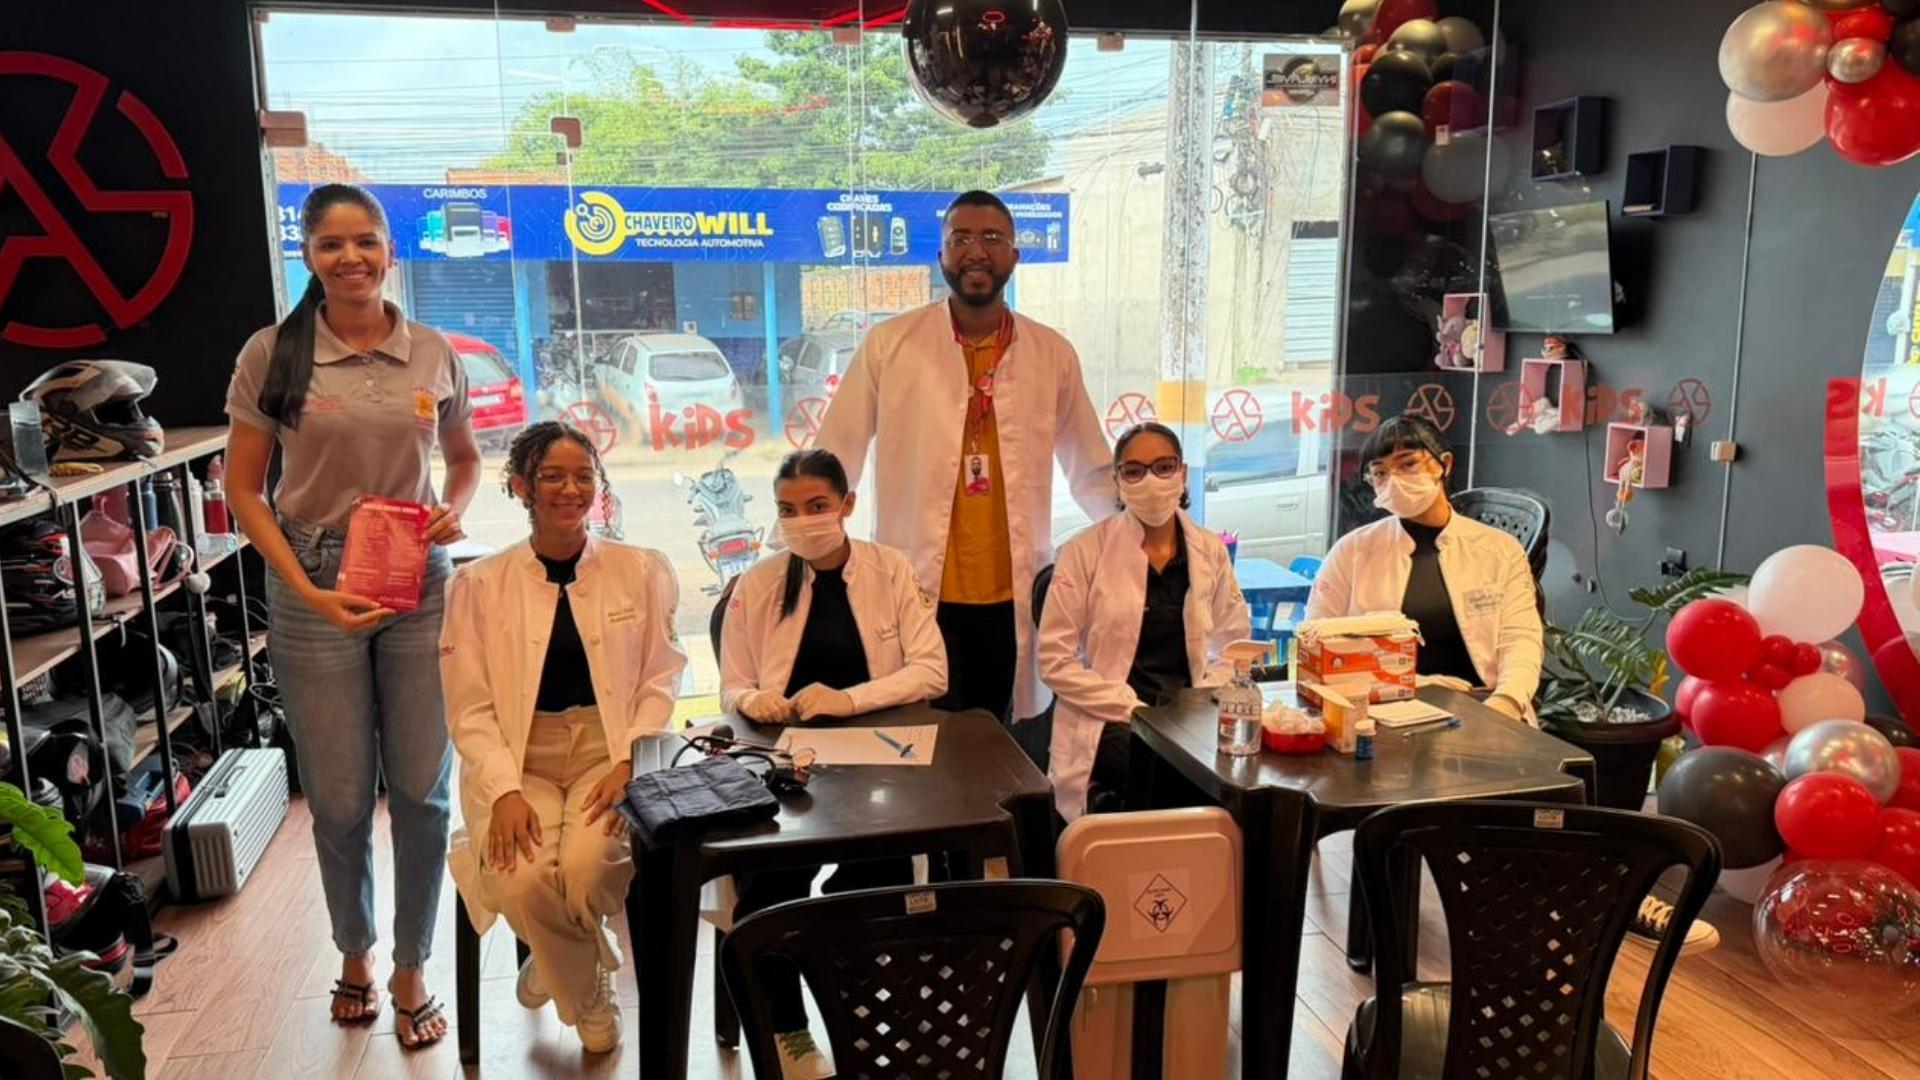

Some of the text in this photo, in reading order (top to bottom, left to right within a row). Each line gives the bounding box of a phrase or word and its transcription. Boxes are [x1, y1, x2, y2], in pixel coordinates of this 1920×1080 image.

[423, 188, 488, 199] CARIMBOS
[840, 194, 880, 203] CHAVES
[625, 211, 774, 236] CHAVEIRO WILL
[636, 238, 764, 248] TECNOLOGIA AUTOMOTIVA
